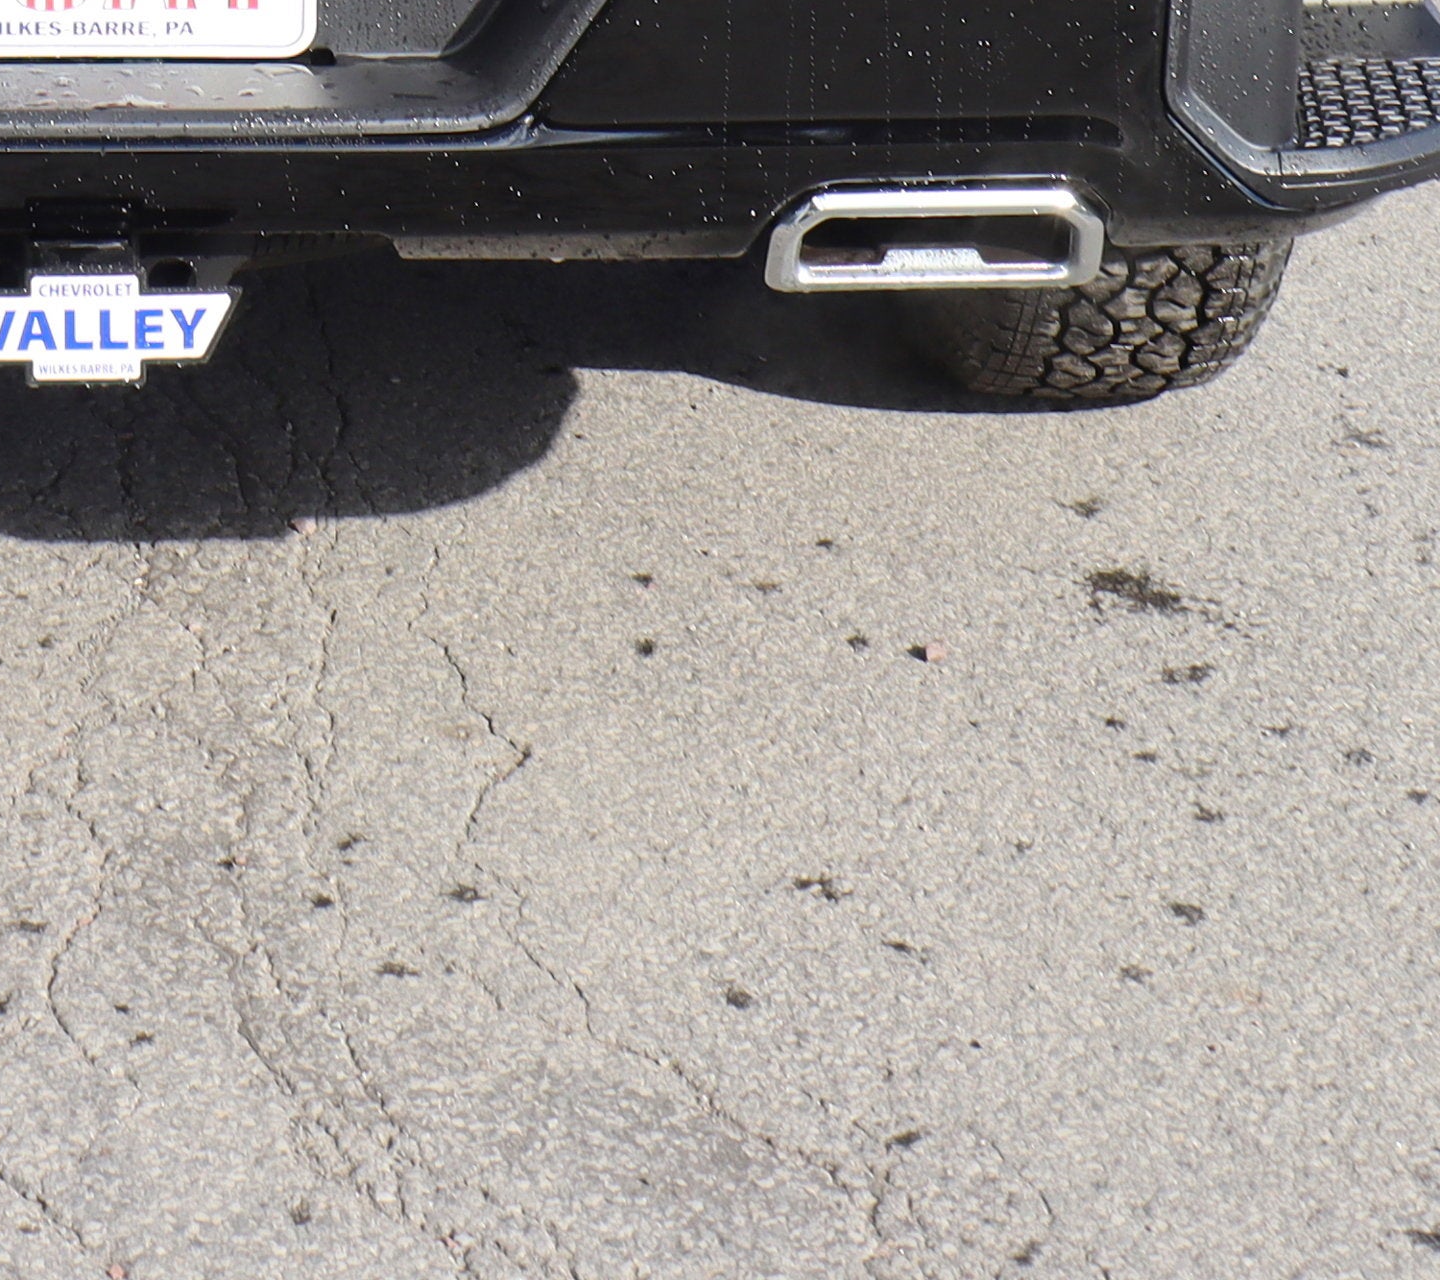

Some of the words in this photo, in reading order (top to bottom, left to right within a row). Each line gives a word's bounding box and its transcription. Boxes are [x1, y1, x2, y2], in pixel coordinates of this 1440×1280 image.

[165, 20, 195, 37] PA
[38, 282, 133, 298] CHEVROLET
[120, 363, 134, 374] PA
